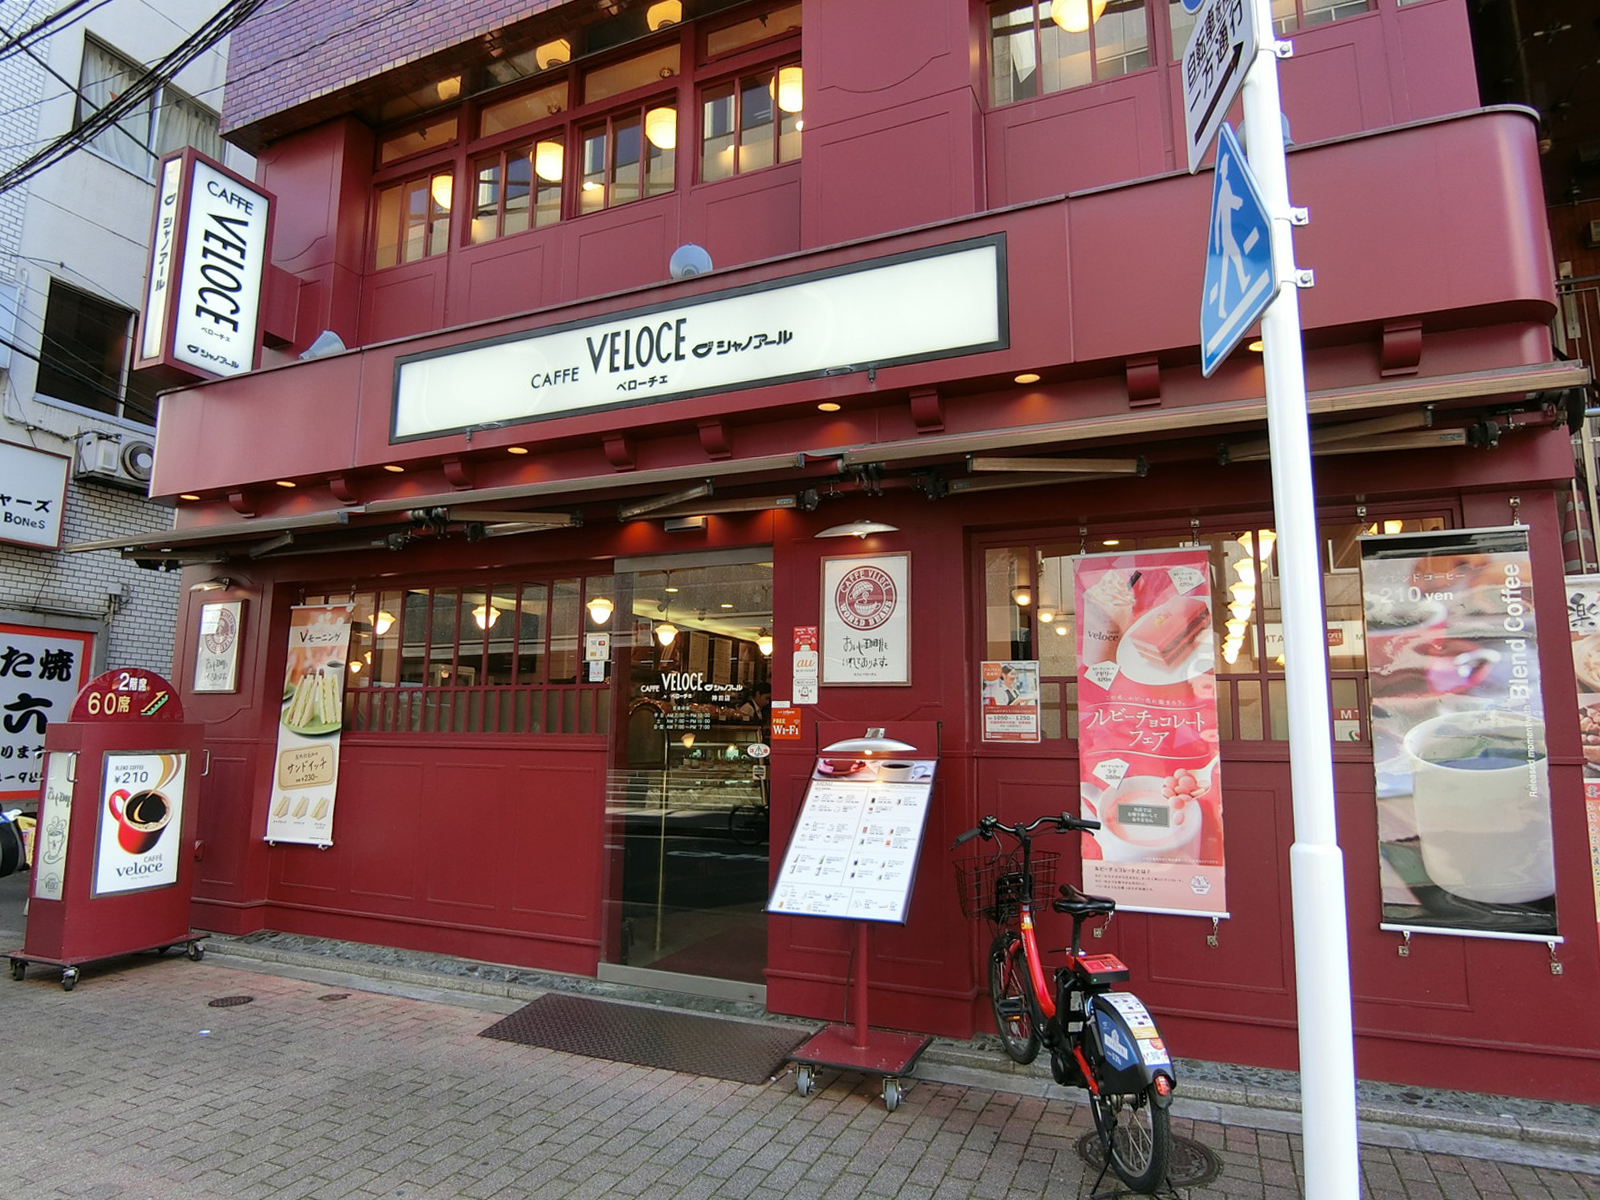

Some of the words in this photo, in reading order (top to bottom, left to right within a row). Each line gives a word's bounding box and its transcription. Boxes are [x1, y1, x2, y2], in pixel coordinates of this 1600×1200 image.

[1190, 0, 1243, 112] 一方通行
[207, 180, 253, 216] CAFFE
[195, 212, 249, 333] VELOCE
[201, 327, 231, 342] ベローチェ
[200, 349, 239, 369] シャノアール
[531, 366, 580, 389] CAFFE
[586, 318, 687, 374] VELOCE
[716, 330, 793, 355] シャノアール
[616, 375, 668, 391] ベローチェ
[840, 569, 865, 593] CAFFE
[868, 569, 892, 591] VELOCE
[1379, 586, 1422, 604] 210
[1424, 591, 1454, 603] yen
[1501, 562, 1525, 632] Coffee
[839, 602, 866, 627] WORLD
[868, 600, 893, 627] BEANS
[1088, 630, 1119, 642] veloce
[796, 658, 816, 668] au
[1506, 638, 1531, 700] Blend
[661, 672, 703, 691] VELOCE
[3, 692, 53, 735] 六
[87, 692, 131, 715] 60席
[1086, 708, 1206, 732] ルビーチョコレート
[1128, 730, 1170, 751] フェア
[287, 757, 327, 774] サンドイッチ
[114, 771, 149, 784] ¥210
[1528, 760, 1538, 798] Released
[115, 862, 164, 878] veloce
